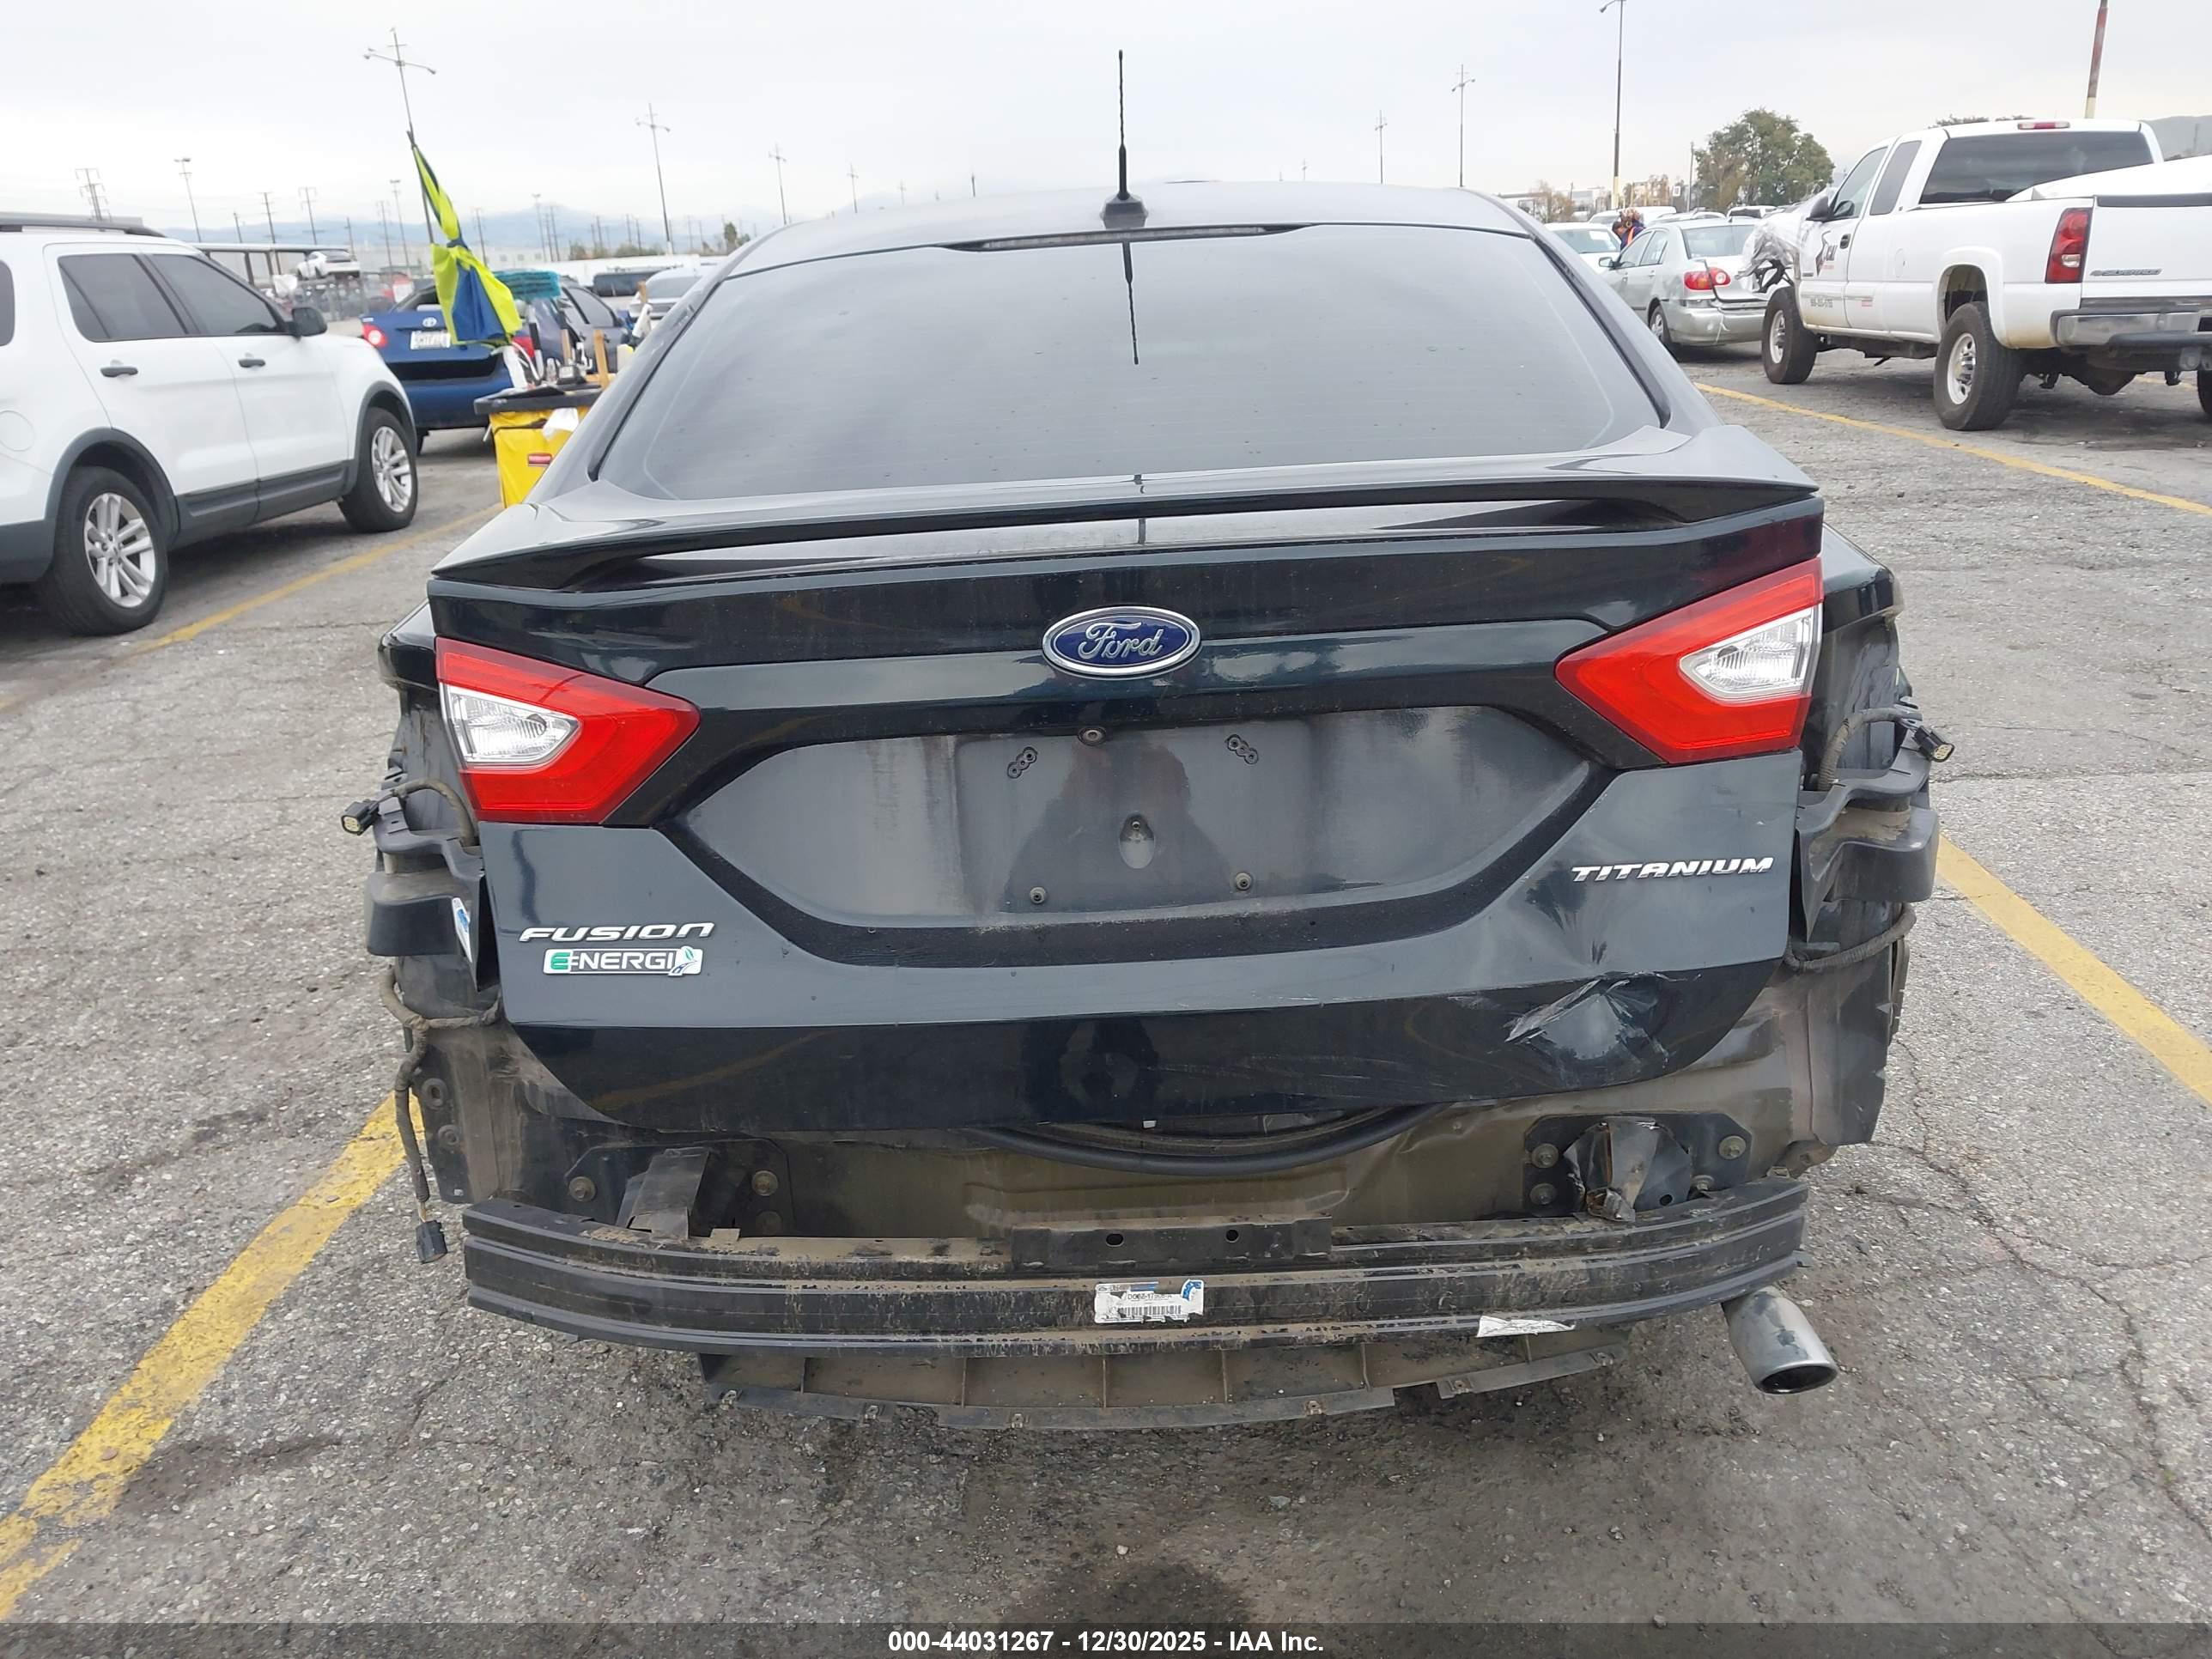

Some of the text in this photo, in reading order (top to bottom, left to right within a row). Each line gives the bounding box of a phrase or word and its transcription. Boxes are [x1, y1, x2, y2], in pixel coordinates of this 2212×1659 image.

[1078, 621, 1164, 659] Ford
[1571, 857, 1774, 882] TITANIUM
[519, 922, 715, 942] FUSION
[550, 951, 673, 970] ENERGI
